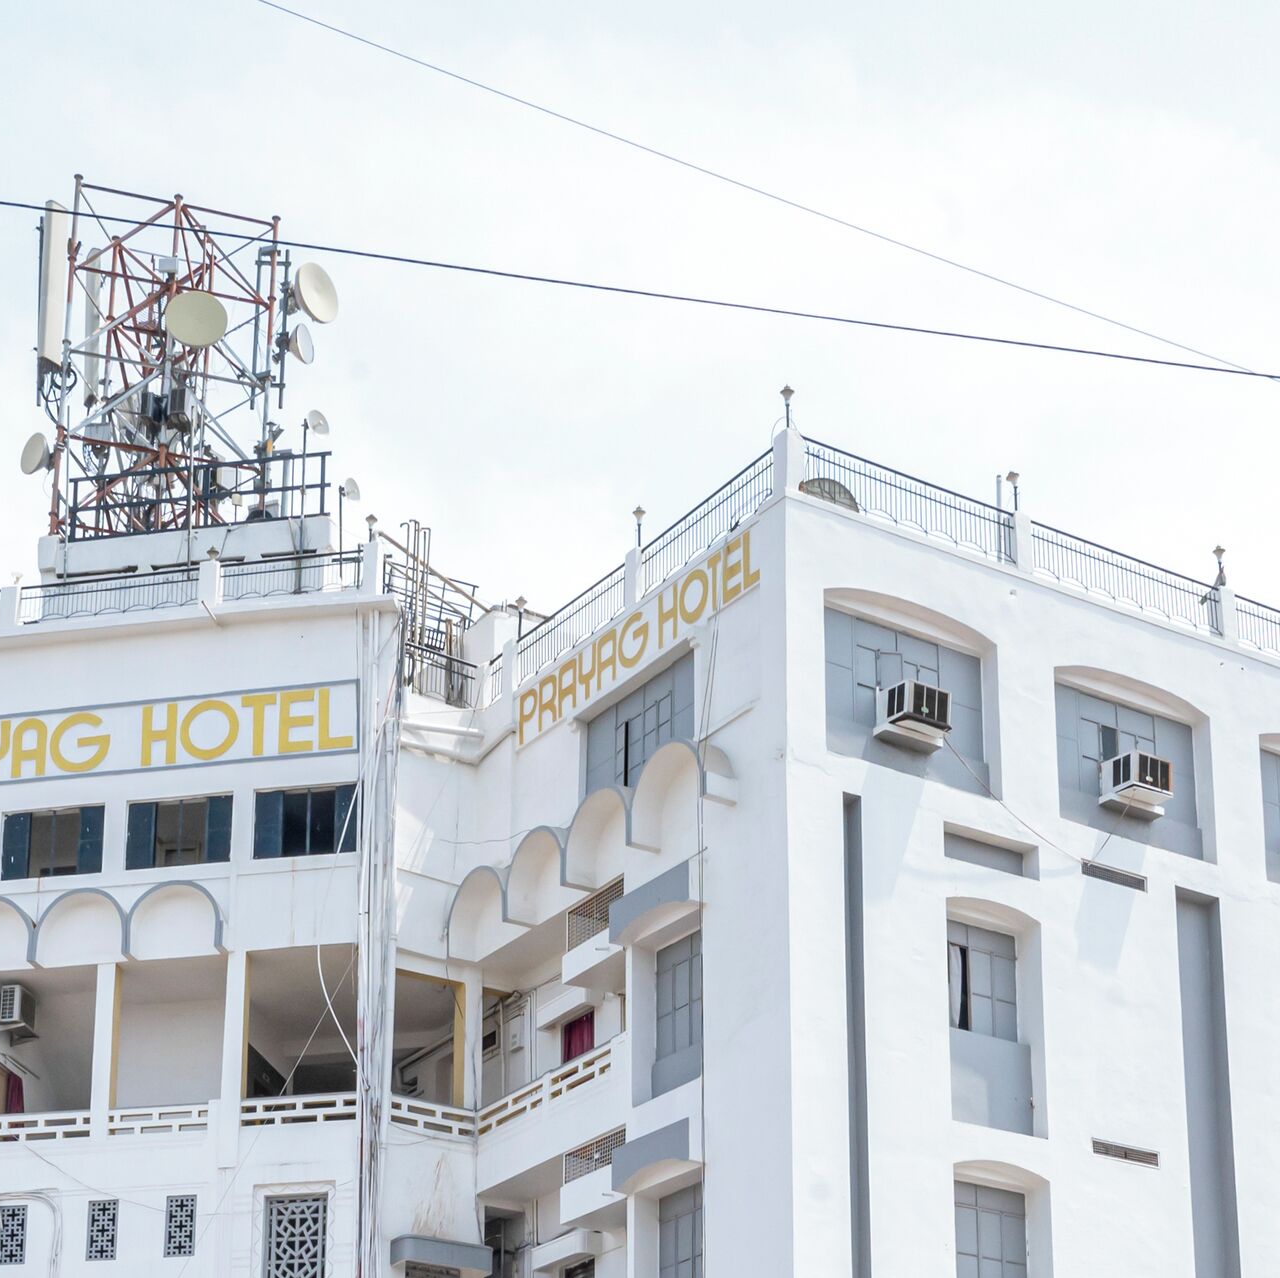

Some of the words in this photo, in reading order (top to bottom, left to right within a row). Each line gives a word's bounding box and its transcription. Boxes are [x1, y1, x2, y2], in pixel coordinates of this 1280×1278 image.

[517, 612, 649, 745] PRAYAG
[657, 530, 761, 650] HOTEL
[140, 687, 354, 767] HOTEL
